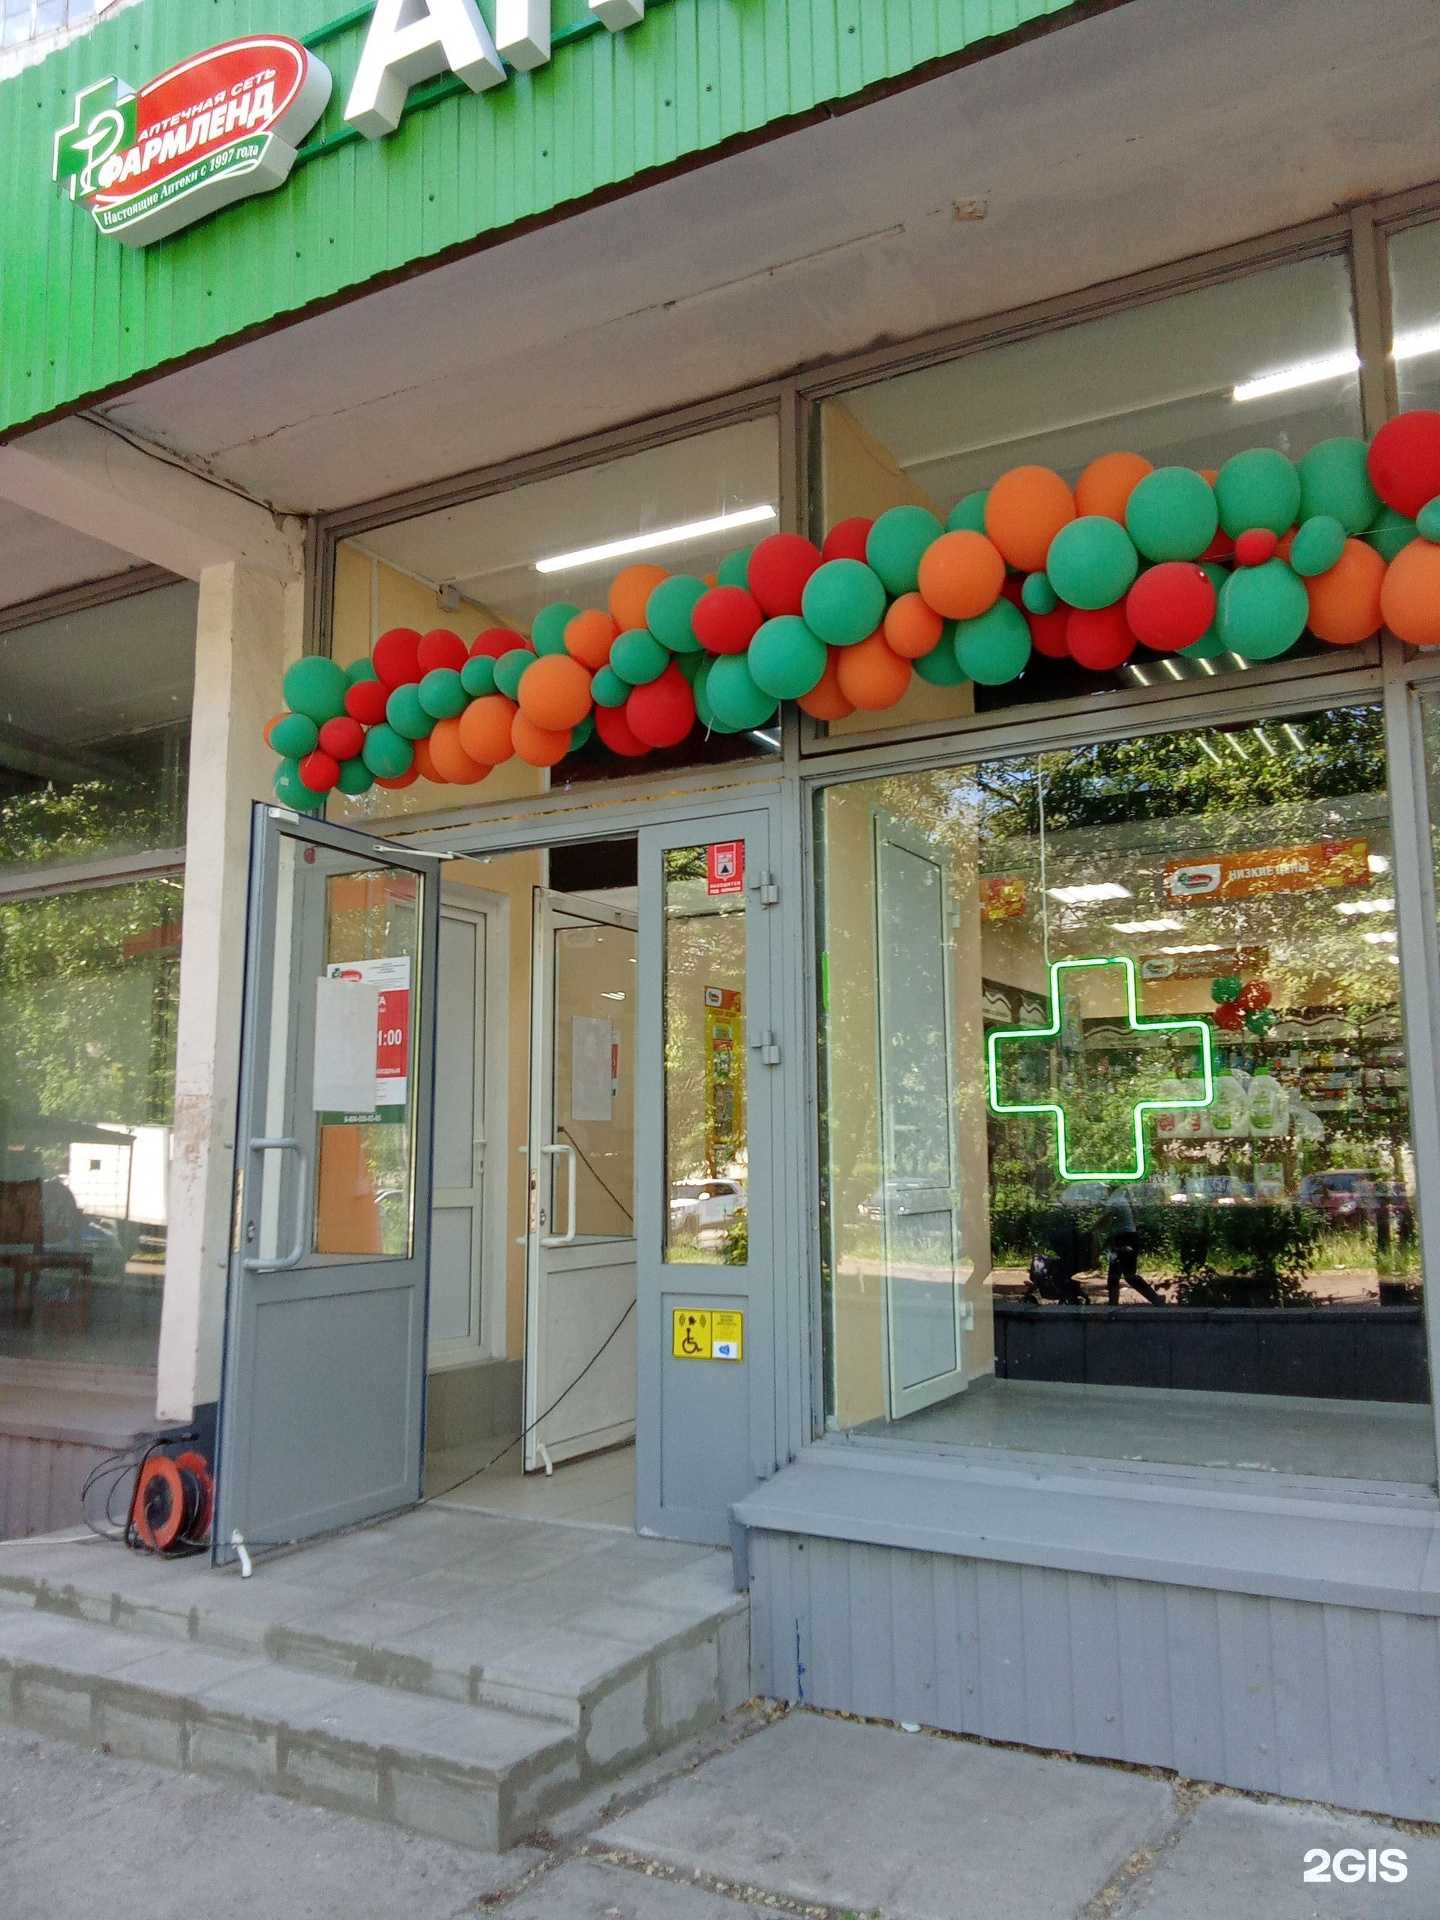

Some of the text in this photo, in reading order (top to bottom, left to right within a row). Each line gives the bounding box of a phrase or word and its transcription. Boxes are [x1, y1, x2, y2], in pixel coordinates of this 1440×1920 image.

[98, 81, 275, 188] ФАРМЛЕНД
[138, 69, 276, 142] АПТЕЧНАЯ СЕТЬ
[104, 194, 158, 225] Настоящие
[161, 170, 198, 198] Аптеки
[208, 151, 233, 173] 1997
[235, 142, 259, 162] года
[1229, 867, 1275, 881] НИЗКИЕ
[377, 1028, 402, 1046] 1:00
